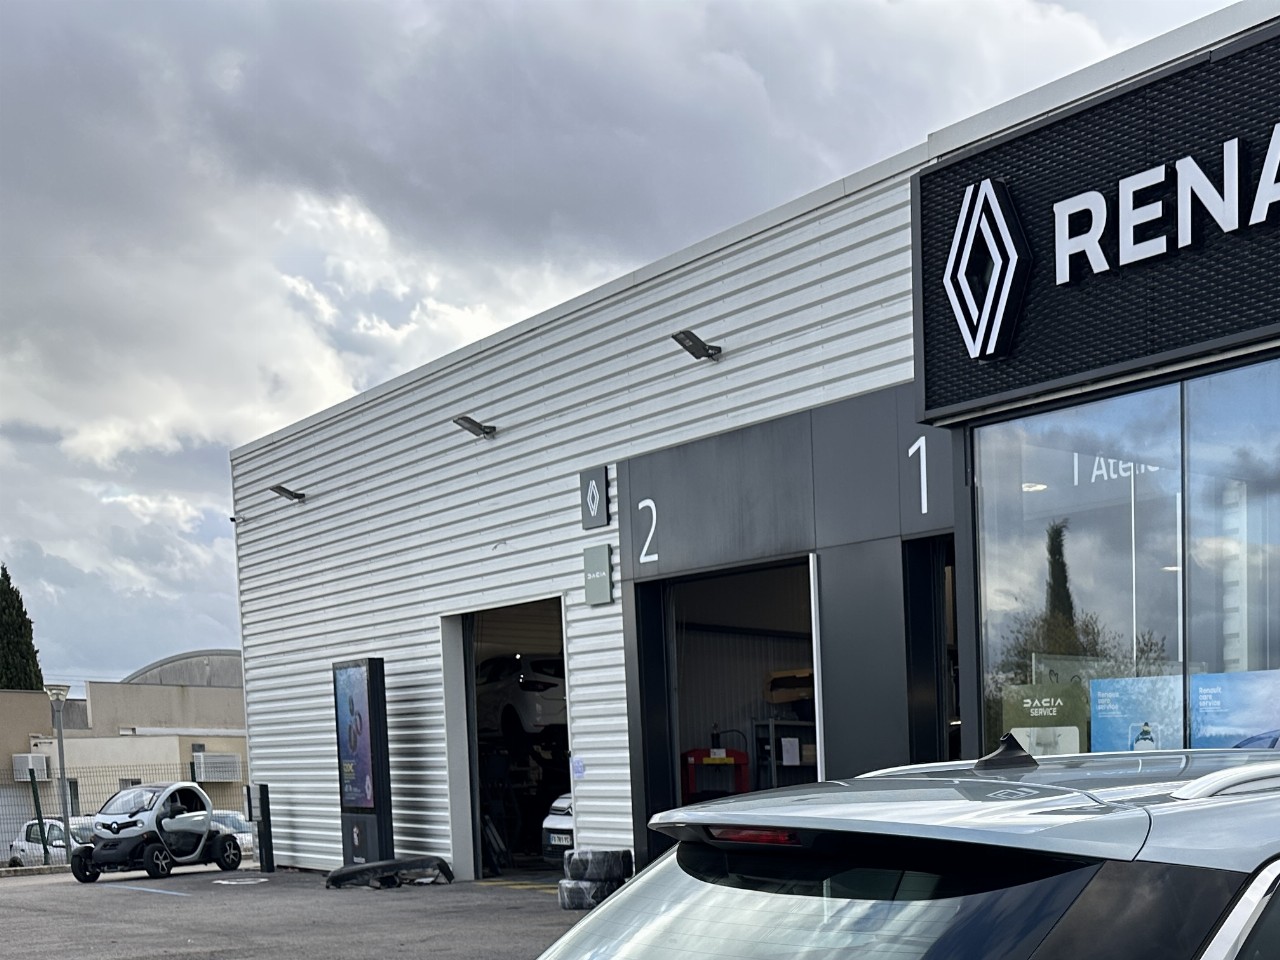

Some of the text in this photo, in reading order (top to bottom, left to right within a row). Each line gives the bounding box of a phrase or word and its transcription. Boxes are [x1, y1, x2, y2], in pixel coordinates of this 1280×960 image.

[908, 435, 928, 514] 1
[638, 498, 659, 564] 2
[1023, 697, 1064, 708] DACIA
[1030, 707, 1057, 717] SERVICE
